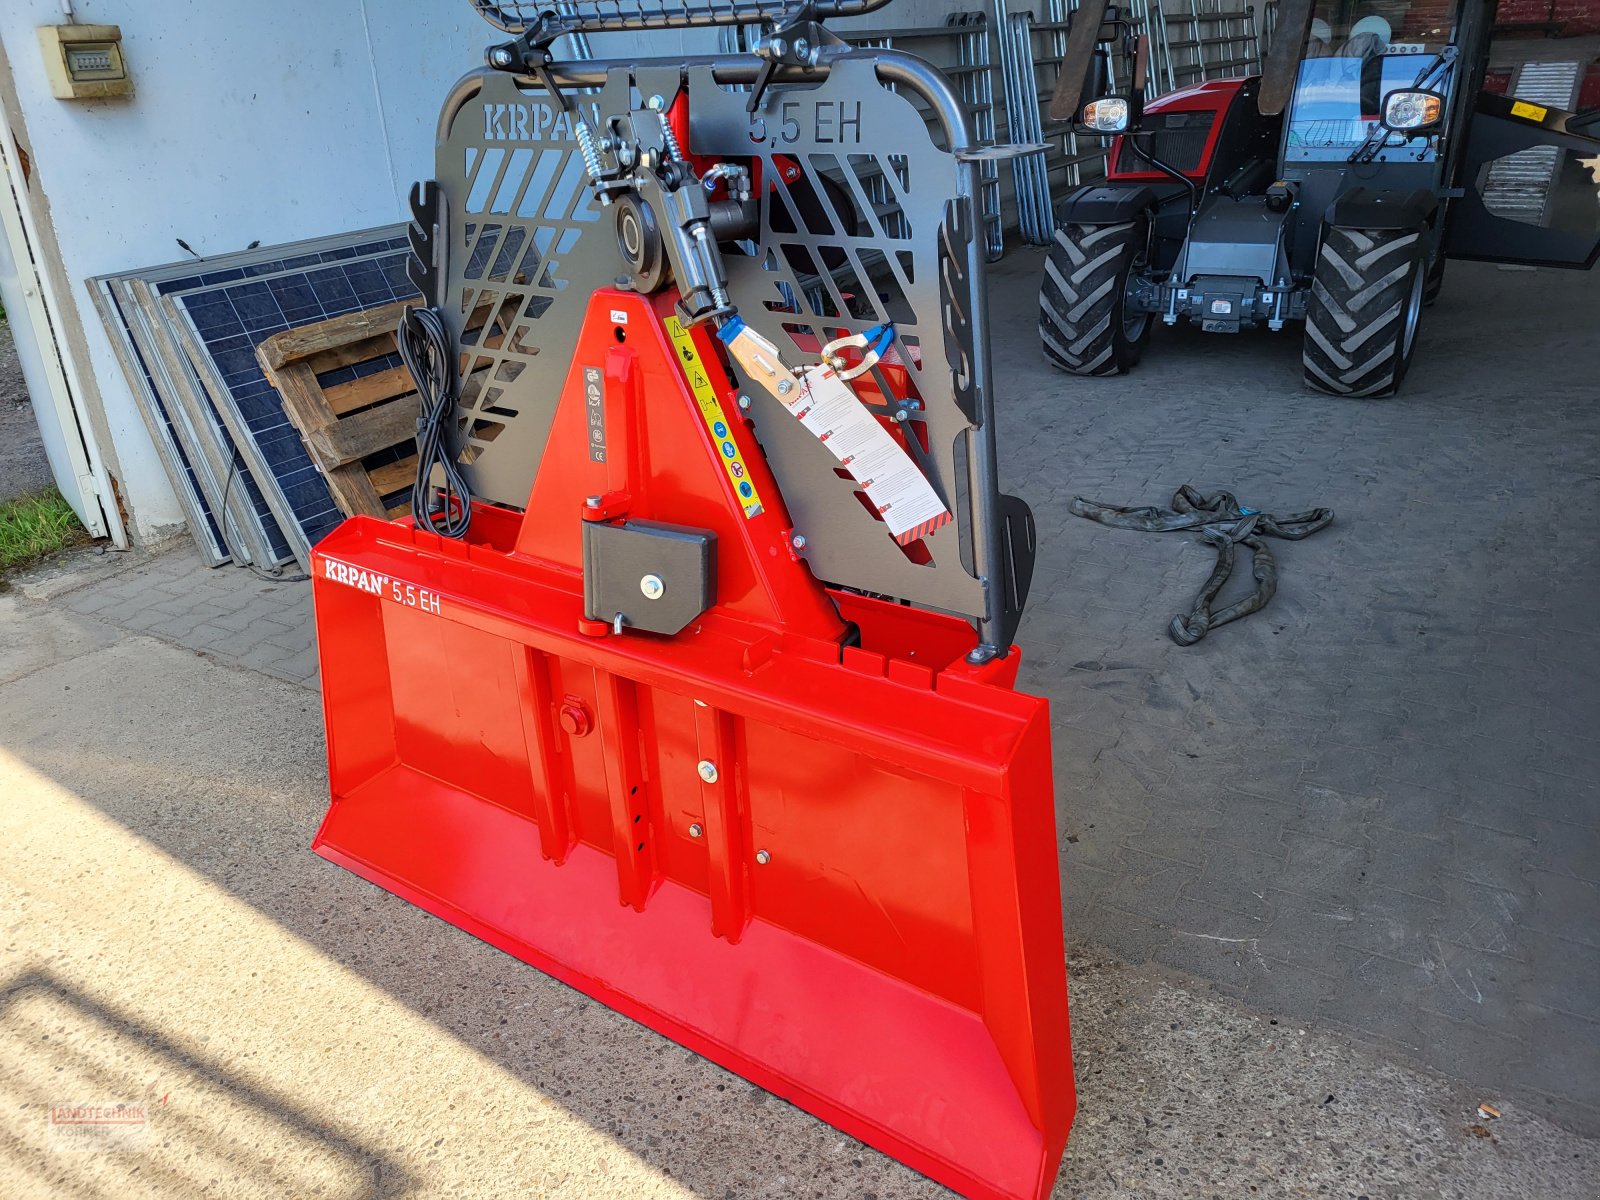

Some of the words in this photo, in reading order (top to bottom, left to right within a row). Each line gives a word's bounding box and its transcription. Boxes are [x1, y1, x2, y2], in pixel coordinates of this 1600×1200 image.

[815, 101, 861, 143] EH
[392, 581, 416, 606] 5,5
[420, 590, 440, 614] EH
